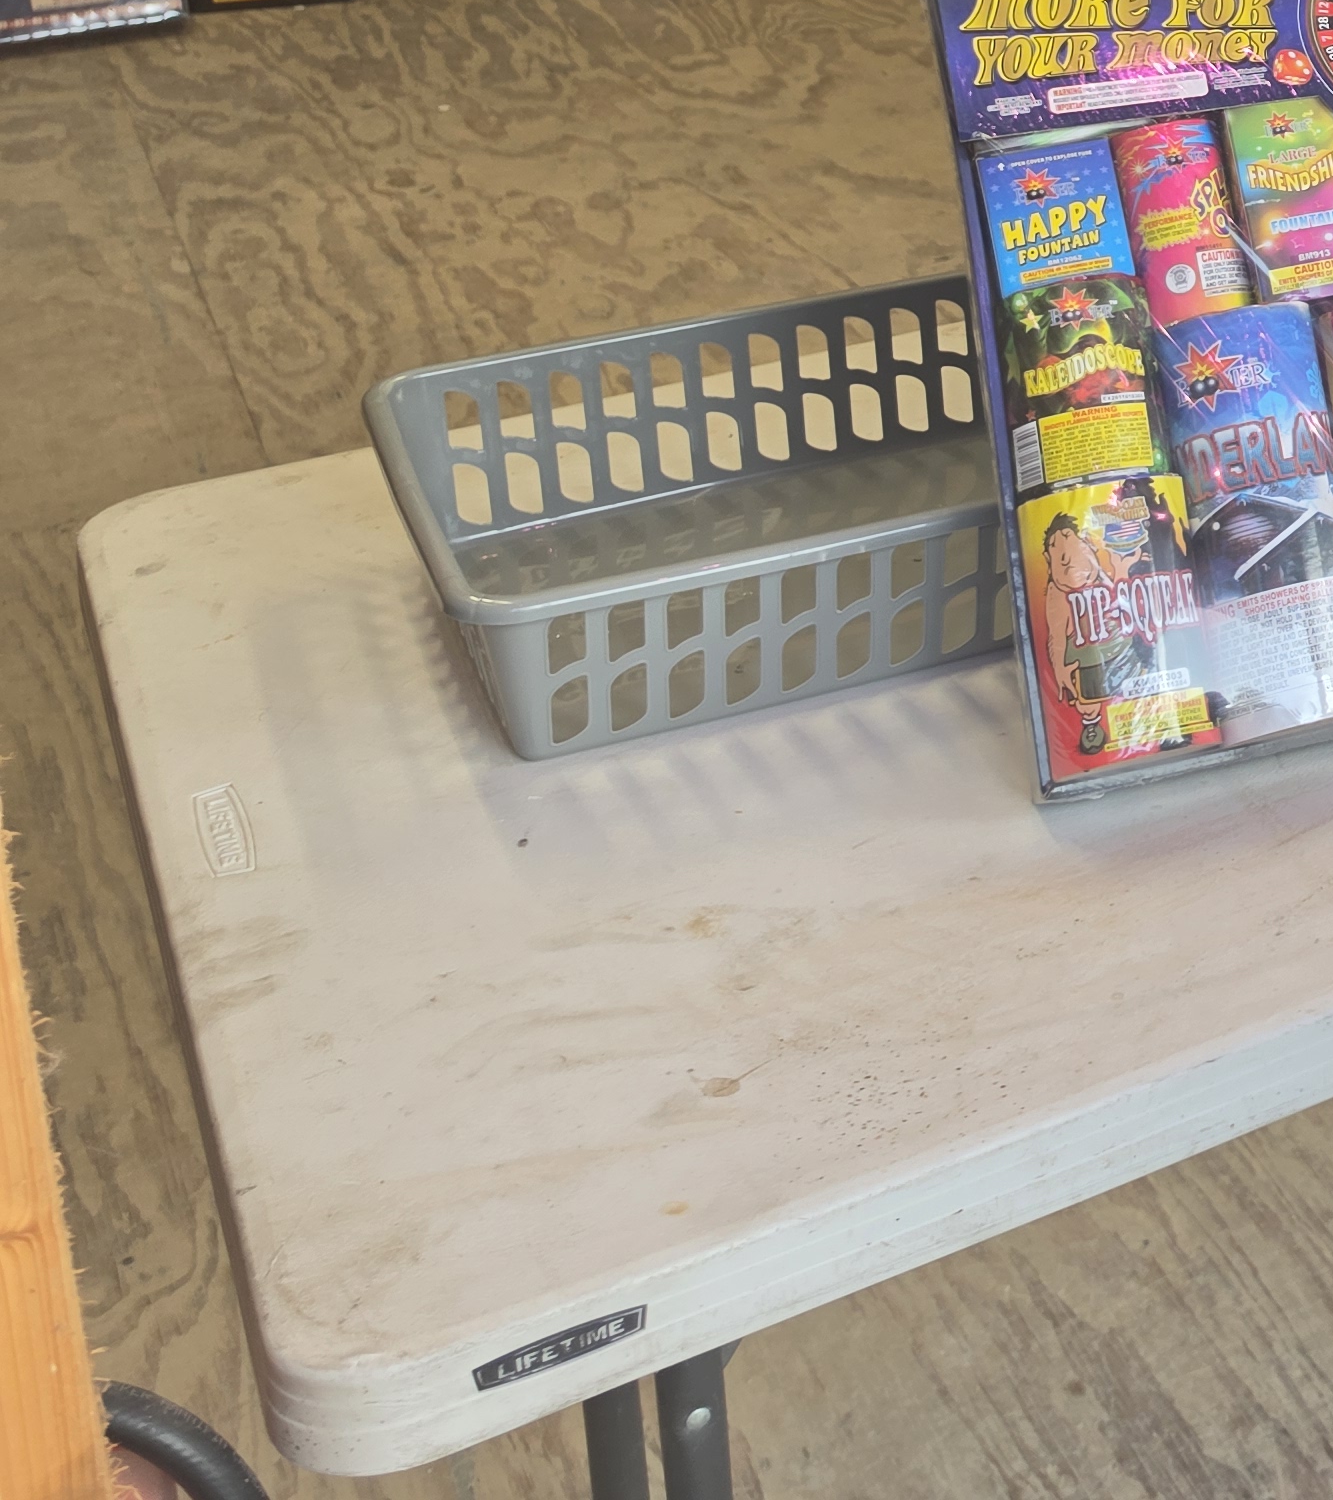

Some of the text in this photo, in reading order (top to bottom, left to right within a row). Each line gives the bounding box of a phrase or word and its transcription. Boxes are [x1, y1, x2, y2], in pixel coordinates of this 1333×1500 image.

[973, 32, 1099, 86] YOUR
[1052, 88, 1082, 96] WARNING
[1269, 147, 1316, 164] LARGE
[1002, 195, 1106, 250] HAPPY
[1143, 213, 1193, 230] PERFORMANCE
[1018, 230, 1099, 265] FOUNTAIN
[1298, 250, 1331, 261] BM913
[1024, 344, 1145, 397] KALEIDOSCOPE
[1072, 406, 1118, 419] WARNING
[1237, 598, 1259, 609] EMITS
[1261, 588, 1298, 602] SHOWERS
[1245, 603, 1275, 616] SHOOTS
[1264, 609, 1283, 619] ADULT
[1276, 615, 1293, 624] HOLD
[200, 796, 242, 870] LIFETIME
[496, 1316, 628, 1382] LIFETIME
